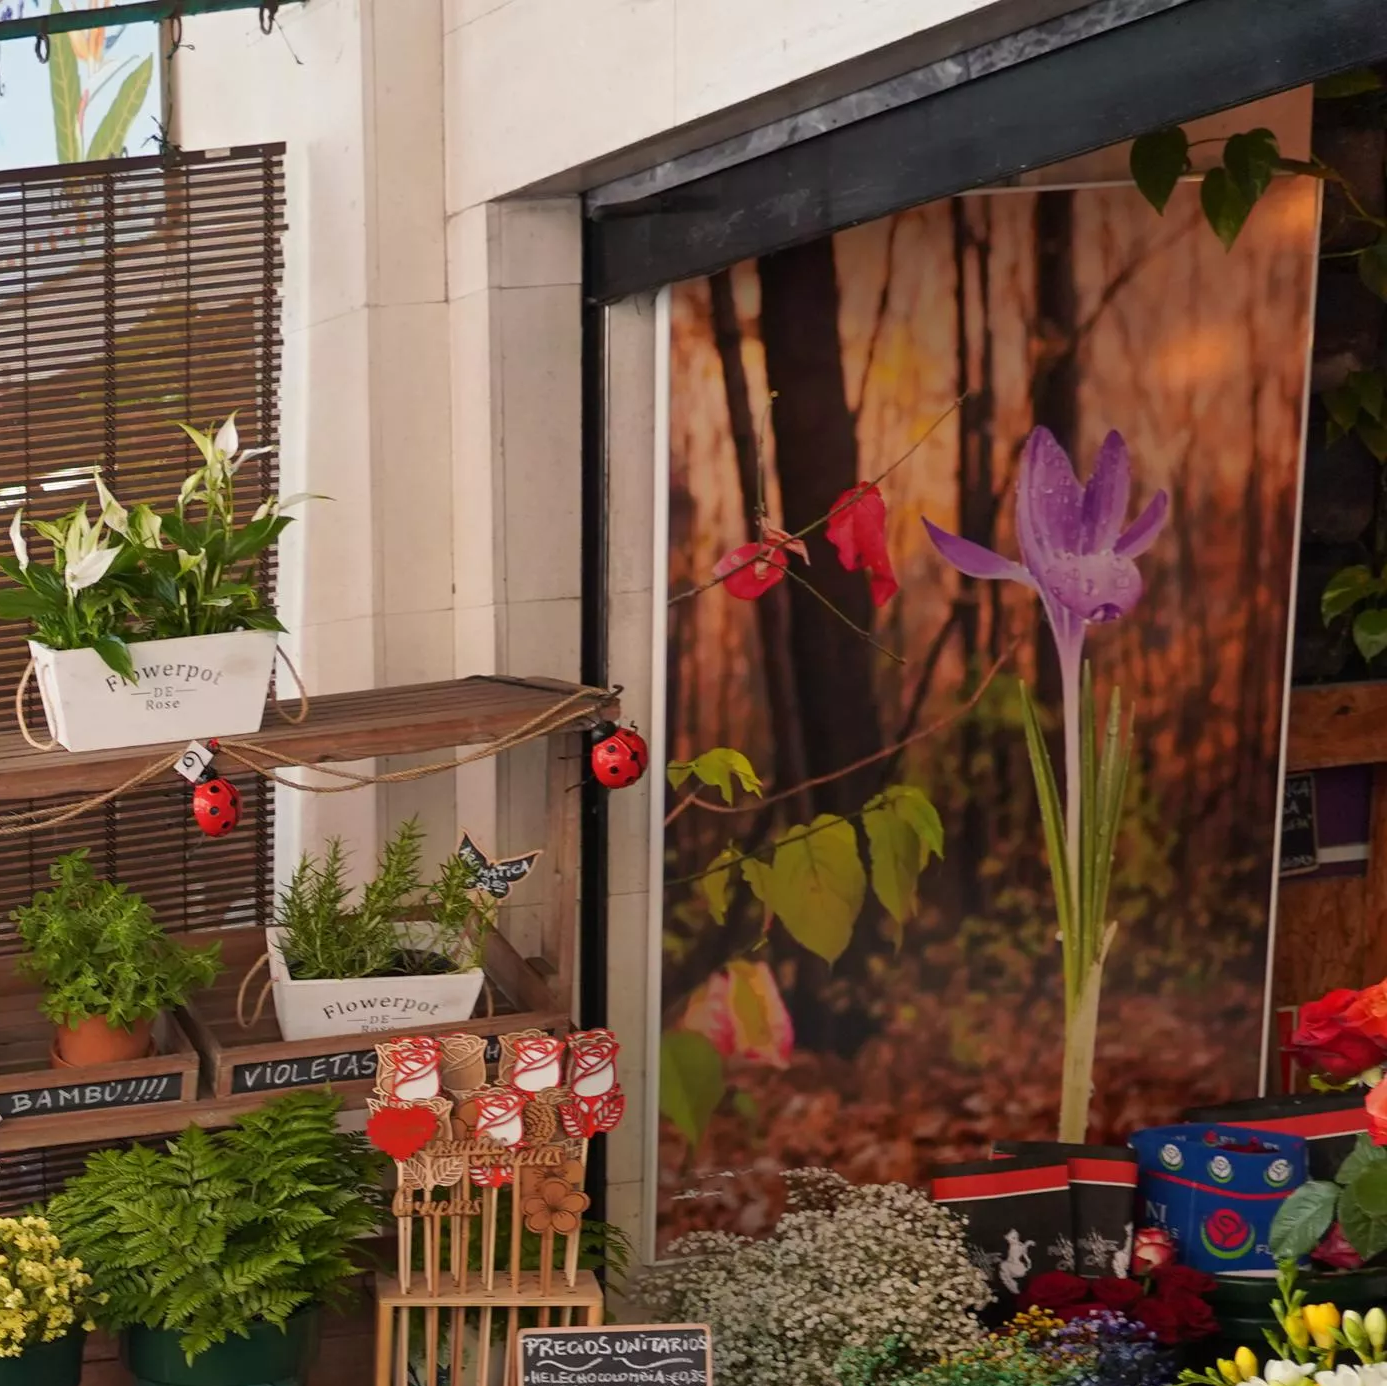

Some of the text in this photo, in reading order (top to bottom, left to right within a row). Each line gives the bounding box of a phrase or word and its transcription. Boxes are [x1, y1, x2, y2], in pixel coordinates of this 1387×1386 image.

[105, 663, 224, 692] Flowerpot
[153, 686, 174, 698] DE
[145, 699, 181, 711] Rose
[322, 995, 444, 1020] Flowerpot
[370, 1014, 390, 1025] DE
